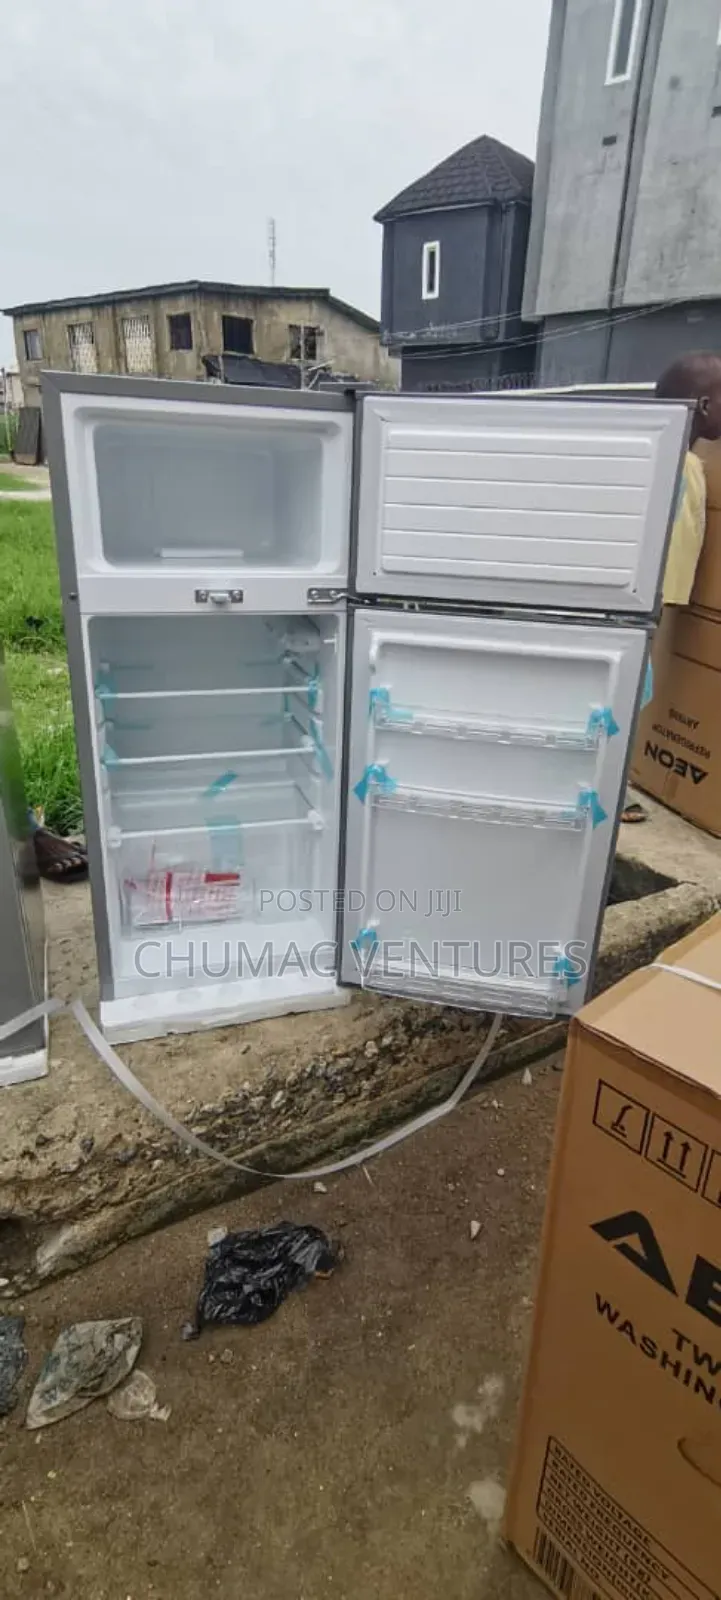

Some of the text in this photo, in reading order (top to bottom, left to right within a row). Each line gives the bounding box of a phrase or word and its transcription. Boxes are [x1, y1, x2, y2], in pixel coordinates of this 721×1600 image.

[644, 740, 709, 785] AEON
[595, 1291, 721, 1409] WASHIN
[590, 1497, 668, 1584] FREQUENCY
[593, 1484, 650, 1549] VOLTAGE
